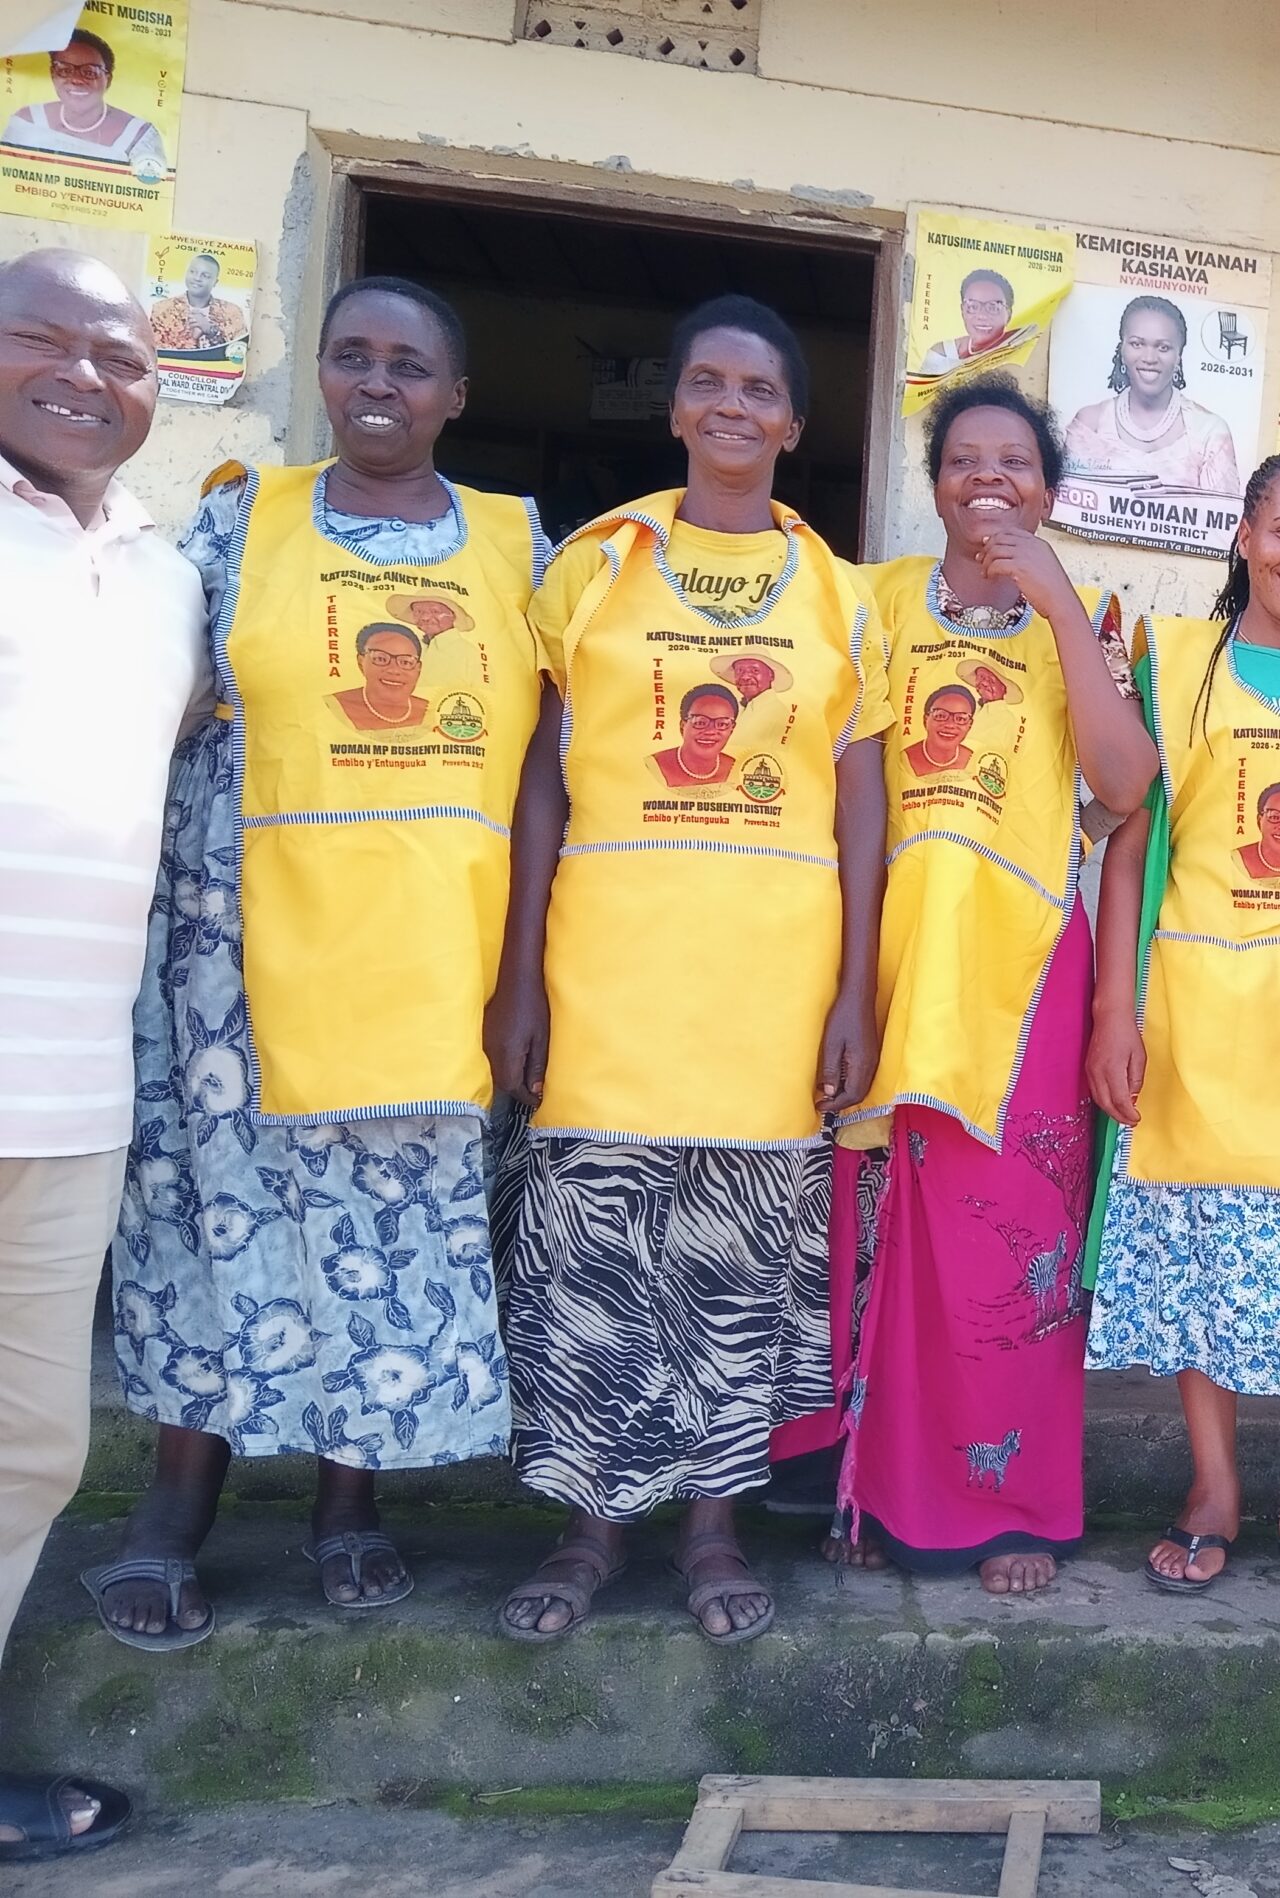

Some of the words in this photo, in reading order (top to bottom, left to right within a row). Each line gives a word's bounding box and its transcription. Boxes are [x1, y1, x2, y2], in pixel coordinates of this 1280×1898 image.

[83, 1, 115, 16] NNET
[117, 7, 173, 27] MUGISHA
[2, 167, 42, 182] WOMAN
[44, 174, 60, 184] MP
[64, 177, 113, 193] BUSHENYI
[115, 185, 160, 200] DISTRICT
[15, 184, 57, 198] EMBIBO
[61, 193, 143, 212] Y'ENTUNGUUKA
[175, 244, 198, 252] JOSE
[201, 248, 226, 256] ZAKA
[217, 242, 254, 252] ZAKARIA
[928, 232, 981, 251] KATUSIIME
[983, 242, 1016, 256] ANNET
[1018, 246, 1063, 263] MUGISHA
[1076, 233, 1179, 263] KEMIGISHA
[1185, 249, 1257, 274] VIANAH
[1121, 258, 1209, 284] KASHAYA
[1120, 275, 1208, 295] NYAMUNYONYI
[923, 274, 932, 330] TEERERA
[168, 373, 217, 384] COUNCILLOR
[1201, 362, 1253, 377] 2026-2031
[192, 382, 219, 393] CENTRAL
[1057, 486, 1095, 508] FOR
[1109, 495, 1197, 525] WOMAN
[1206, 511, 1238, 531] MP
[1081, 512, 1146, 531] BUSHENYI
[1150, 523, 1208, 540] DISTRICT
[1132, 537, 1167, 548] Emanzi
[1169, 542, 1181, 551] Ya
[327, 595, 341, 677] TEERERA
[646, 631, 707, 645] KATUSIIME
[708, 636, 743, 646] ANNET
[745, 635, 794, 649] MUGISHA
[652, 658, 665, 740] TEERERA
[903, 667, 919, 736] TEERERA
[330, 744, 371, 755] WOMAN
[373, 744, 388, 755] MP
[391, 744, 440, 755] BUSHENYI
[443, 744, 485, 757] DISTRICT
[332, 758, 364, 767] Embibo
[643, 801, 678, 811] WOMAN
[680, 801, 695, 812] MP
[697, 802, 742, 813] BUSHENYI
[744, 803, 782, 816] DISTRICT
[937, 785, 977, 800] BUSHENYI
[978, 794, 1003, 816] DISTRICT
[1237, 758, 1246, 835] TEERERA
[643, 814, 672, 823] Embibo
[1231, 889, 1260, 899] WOMAN
[1261, 890, 1273, 900] MP
